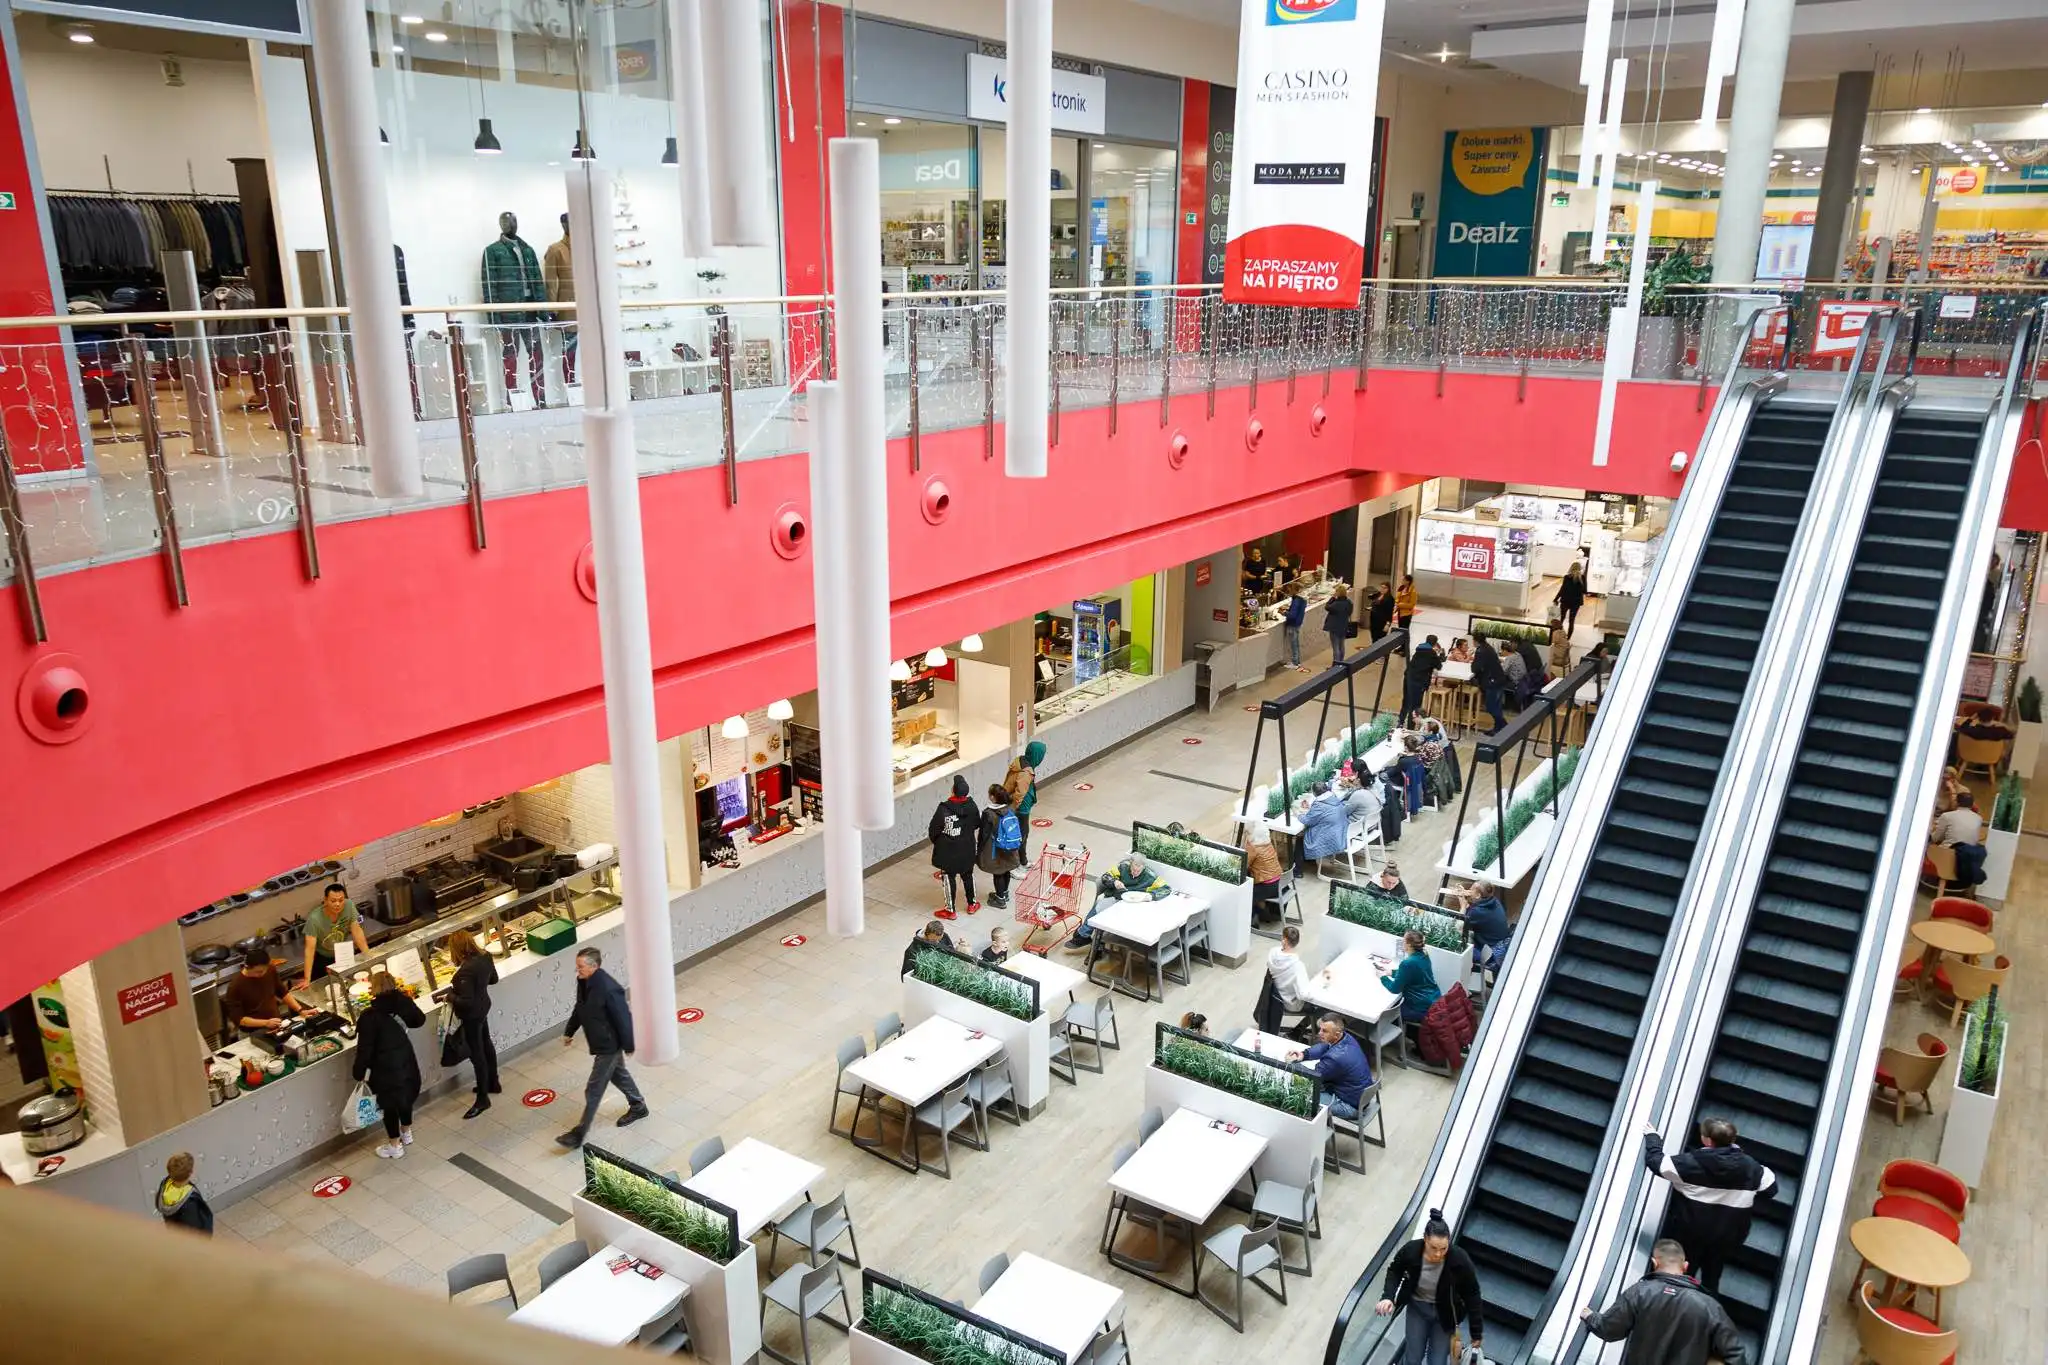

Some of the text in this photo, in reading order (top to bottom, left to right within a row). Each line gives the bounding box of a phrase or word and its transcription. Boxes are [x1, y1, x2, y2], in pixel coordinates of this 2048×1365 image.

[1264, 68, 1348, 91] CASINO
[1295, 89, 1350, 101] FASHION
[1462, 136, 1491, 147] Dobre
[1463, 149, 1520, 162] Super ceny.
[1259, 167, 1293, 176] MODA
[1299, 166, 1340, 177] MĘSKA
[1470, 163, 1511, 174] Zawsze!
[1448, 220, 1519, 244] Dealz
[1244, 258, 1340, 275] ZAPRASZAMY
[1242, 273, 1266, 288] NA
[1277, 274, 1339, 293] PIĘTRO
[1463, 541, 1484, 549] FREE
[126, 978, 164, 999] ZWROT
[125, 986, 170, 1010] NACZYŃ
